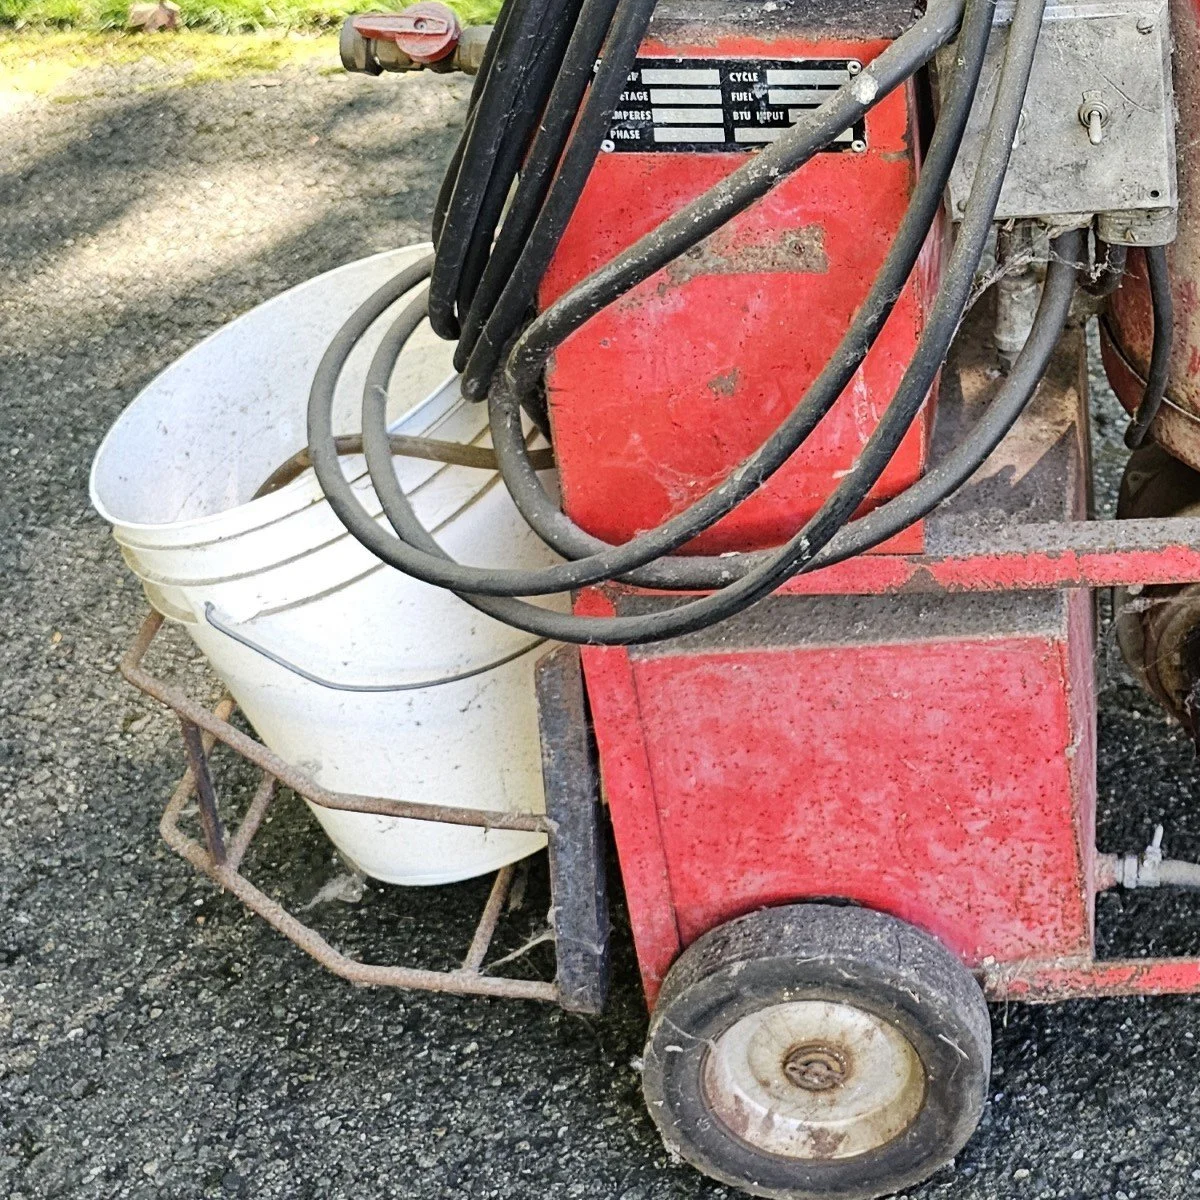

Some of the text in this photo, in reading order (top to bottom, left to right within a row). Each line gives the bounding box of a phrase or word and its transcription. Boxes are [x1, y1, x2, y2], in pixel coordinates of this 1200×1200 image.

[729, 71, 759, 82] CYCLE
[731, 92, 754, 102] FUEL
[612, 110, 652, 121] MPERES
[732, 111, 785, 121] BTU INPUT
[610, 129, 641, 140] PHASE
